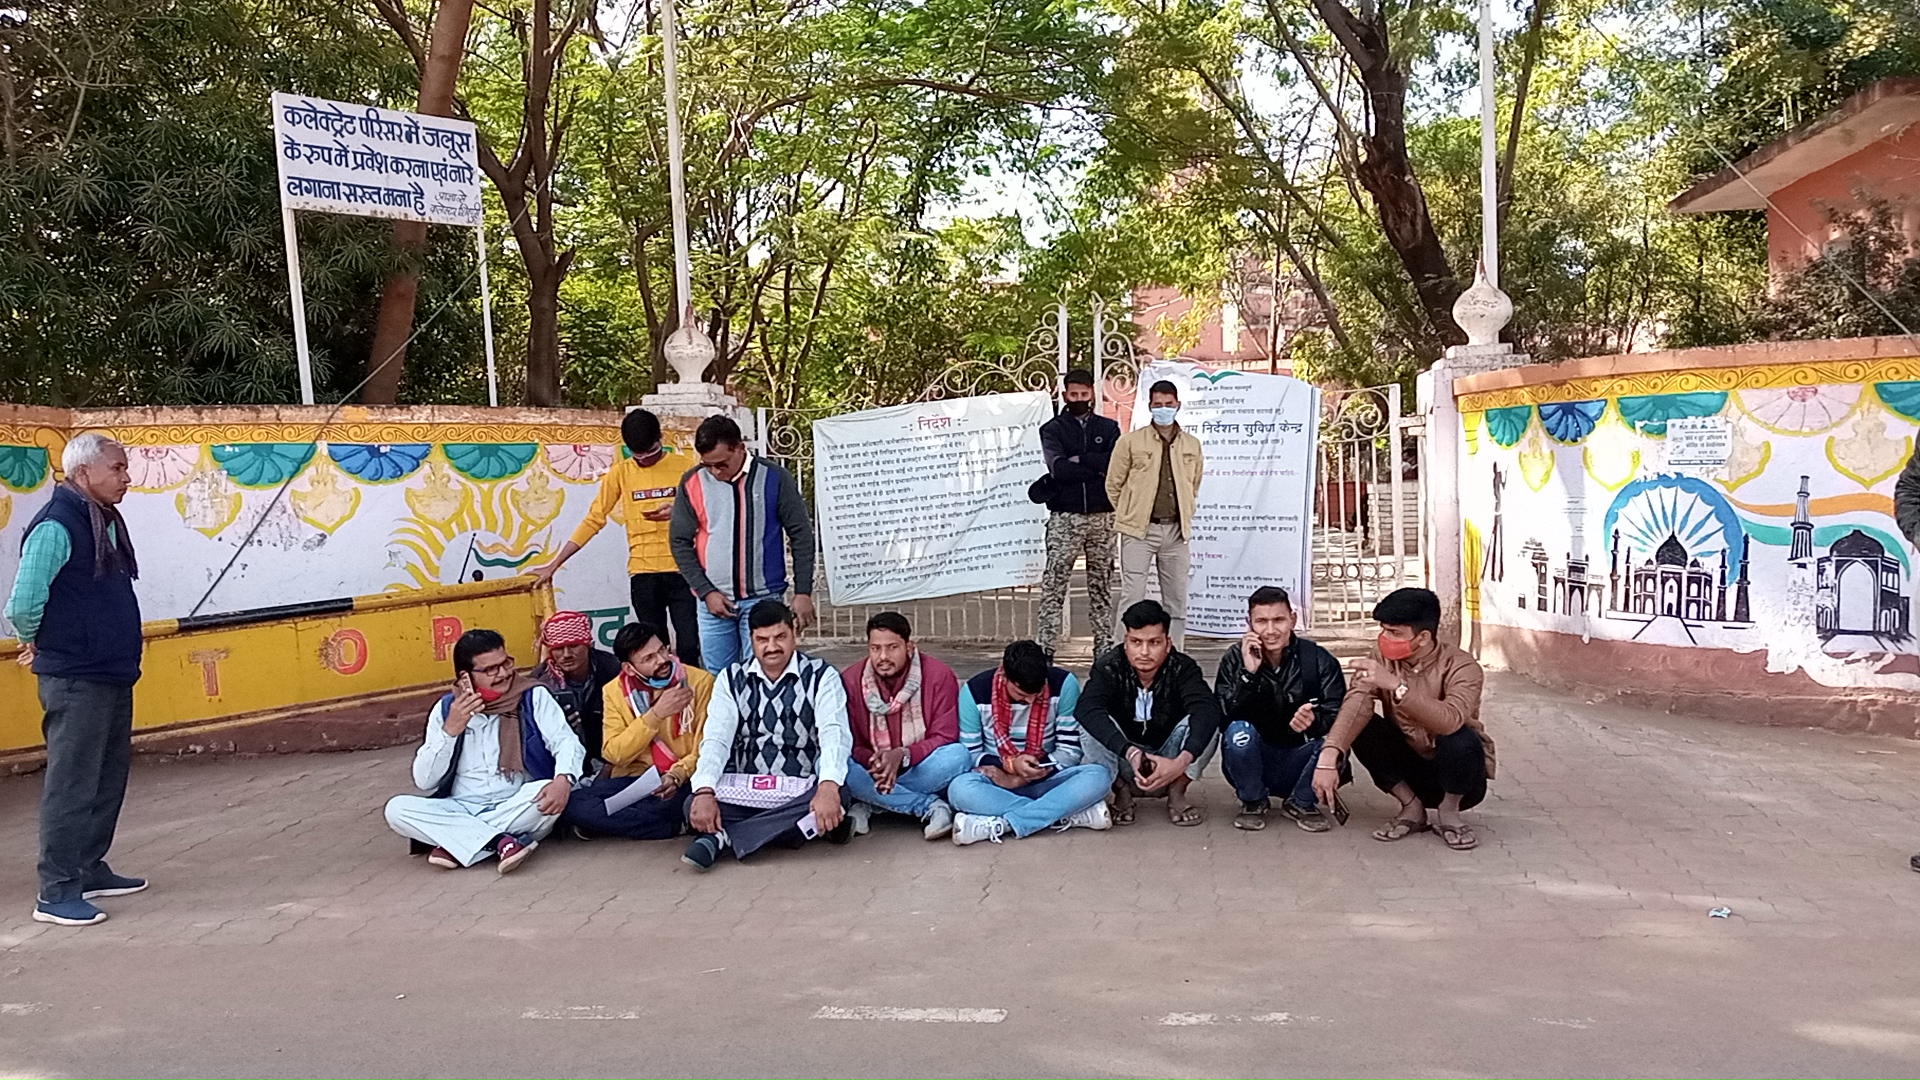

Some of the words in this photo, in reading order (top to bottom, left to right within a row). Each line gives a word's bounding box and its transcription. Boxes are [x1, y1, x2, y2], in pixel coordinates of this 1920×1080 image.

[283, 100, 356, 138] कलेक्ट्रेट
[359, 108, 403, 142] परिसर
[404, 115, 420, 144] में
[423, 126, 471, 160] जलूस
[282, 133, 300, 161] के
[333, 139, 349, 168] में
[351, 144, 388, 174] प्रवेश
[390, 156, 428, 179] करना
[430, 158, 448, 187] एवं
[449, 159, 474, 185] नारे
[287, 175, 341, 200] लगाना
[342, 182, 382, 205] सख्त
[384, 188, 411, 208] मना
[409, 182, 426, 216] है
[1202, 420, 1239, 434] निर्देशन
[1243, 420, 1275, 437] सुविधा
[1279, 420, 1303, 434] केन्द्र
